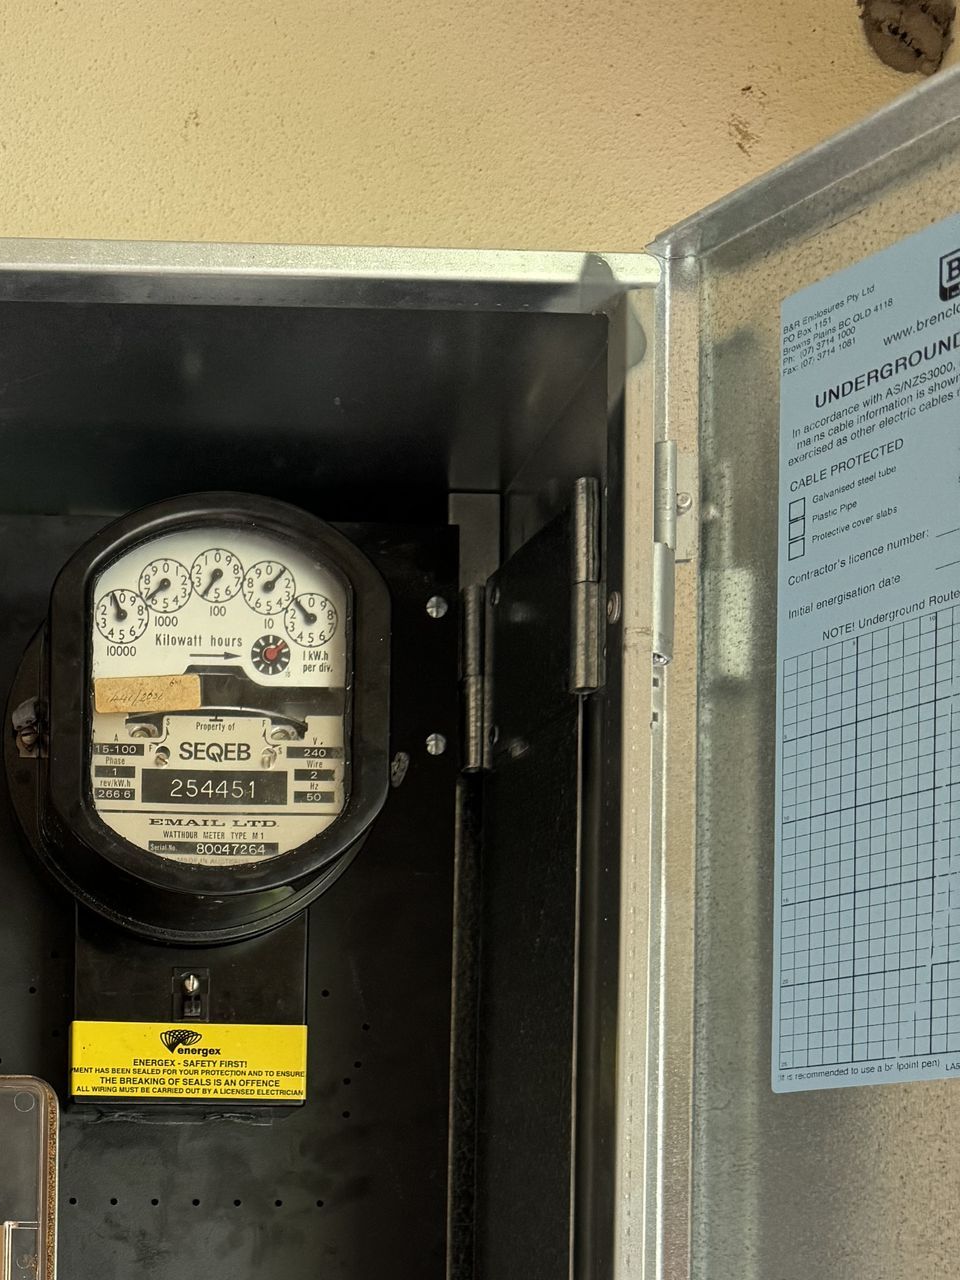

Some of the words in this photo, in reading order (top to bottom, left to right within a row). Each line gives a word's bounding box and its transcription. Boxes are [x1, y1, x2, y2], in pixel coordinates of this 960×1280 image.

[803, 403, 859, 434] accordance
[862, 393, 882, 408] with
[885, 361, 956, 400] AS/NZS3000,
[827, 418, 854, 435] cable
[857, 394, 913, 427] information
[788, 440, 834, 467] exercised
[851, 425, 875, 441] other
[879, 407, 916, 428] electric
[919, 393, 953, 413] cables
[790, 469, 827, 492] CABLE
[831, 438, 904, 476] PROTECTED
[788, 558, 846, 587] Contractor's
[849, 545, 884, 565] licence
[887, 530, 929, 551] number:
[788, 603, 813, 619] Initial
[816, 583, 875, 611] energisation
[209, 606, 226, 616] 100
[154, 616, 178, 627] 1000
[265, 619, 273, 629] 10
[823, 623, 855, 641] NOTE!
[859, 599, 925, 630] Underground
[155, 634, 202, 646] Kilowatt
[211, 636, 242, 647] hours
[106, 646, 136, 657] 10000
[302, 664, 316, 673] per
[319, 663, 333, 672] div.
[196, 721, 224, 732] Property
[224, 722, 235, 731] of
[96, 745, 136, 753] 15-100
[179, 742, 251, 762] SEQEB
[304, 749, 326, 757] 240
[307, 760, 323, 768] Wire
[100, 779, 131, 787] rev/kW.h
[310, 782, 318, 790] Hz
[170, 780, 256, 799] 254451
[307, 793, 321, 801] 50
[149, 818, 225, 827] EMAIL
[163, 831, 197, 839] WATTHOUR
[231, 832, 247, 840] TYPE
[177, 1046, 221, 1057] energex
[133, 1059, 174, 1067] ENERGEX
[183, 1060, 217, 1068] SAFETY
[120, 1077, 165, 1085] BREAKING
